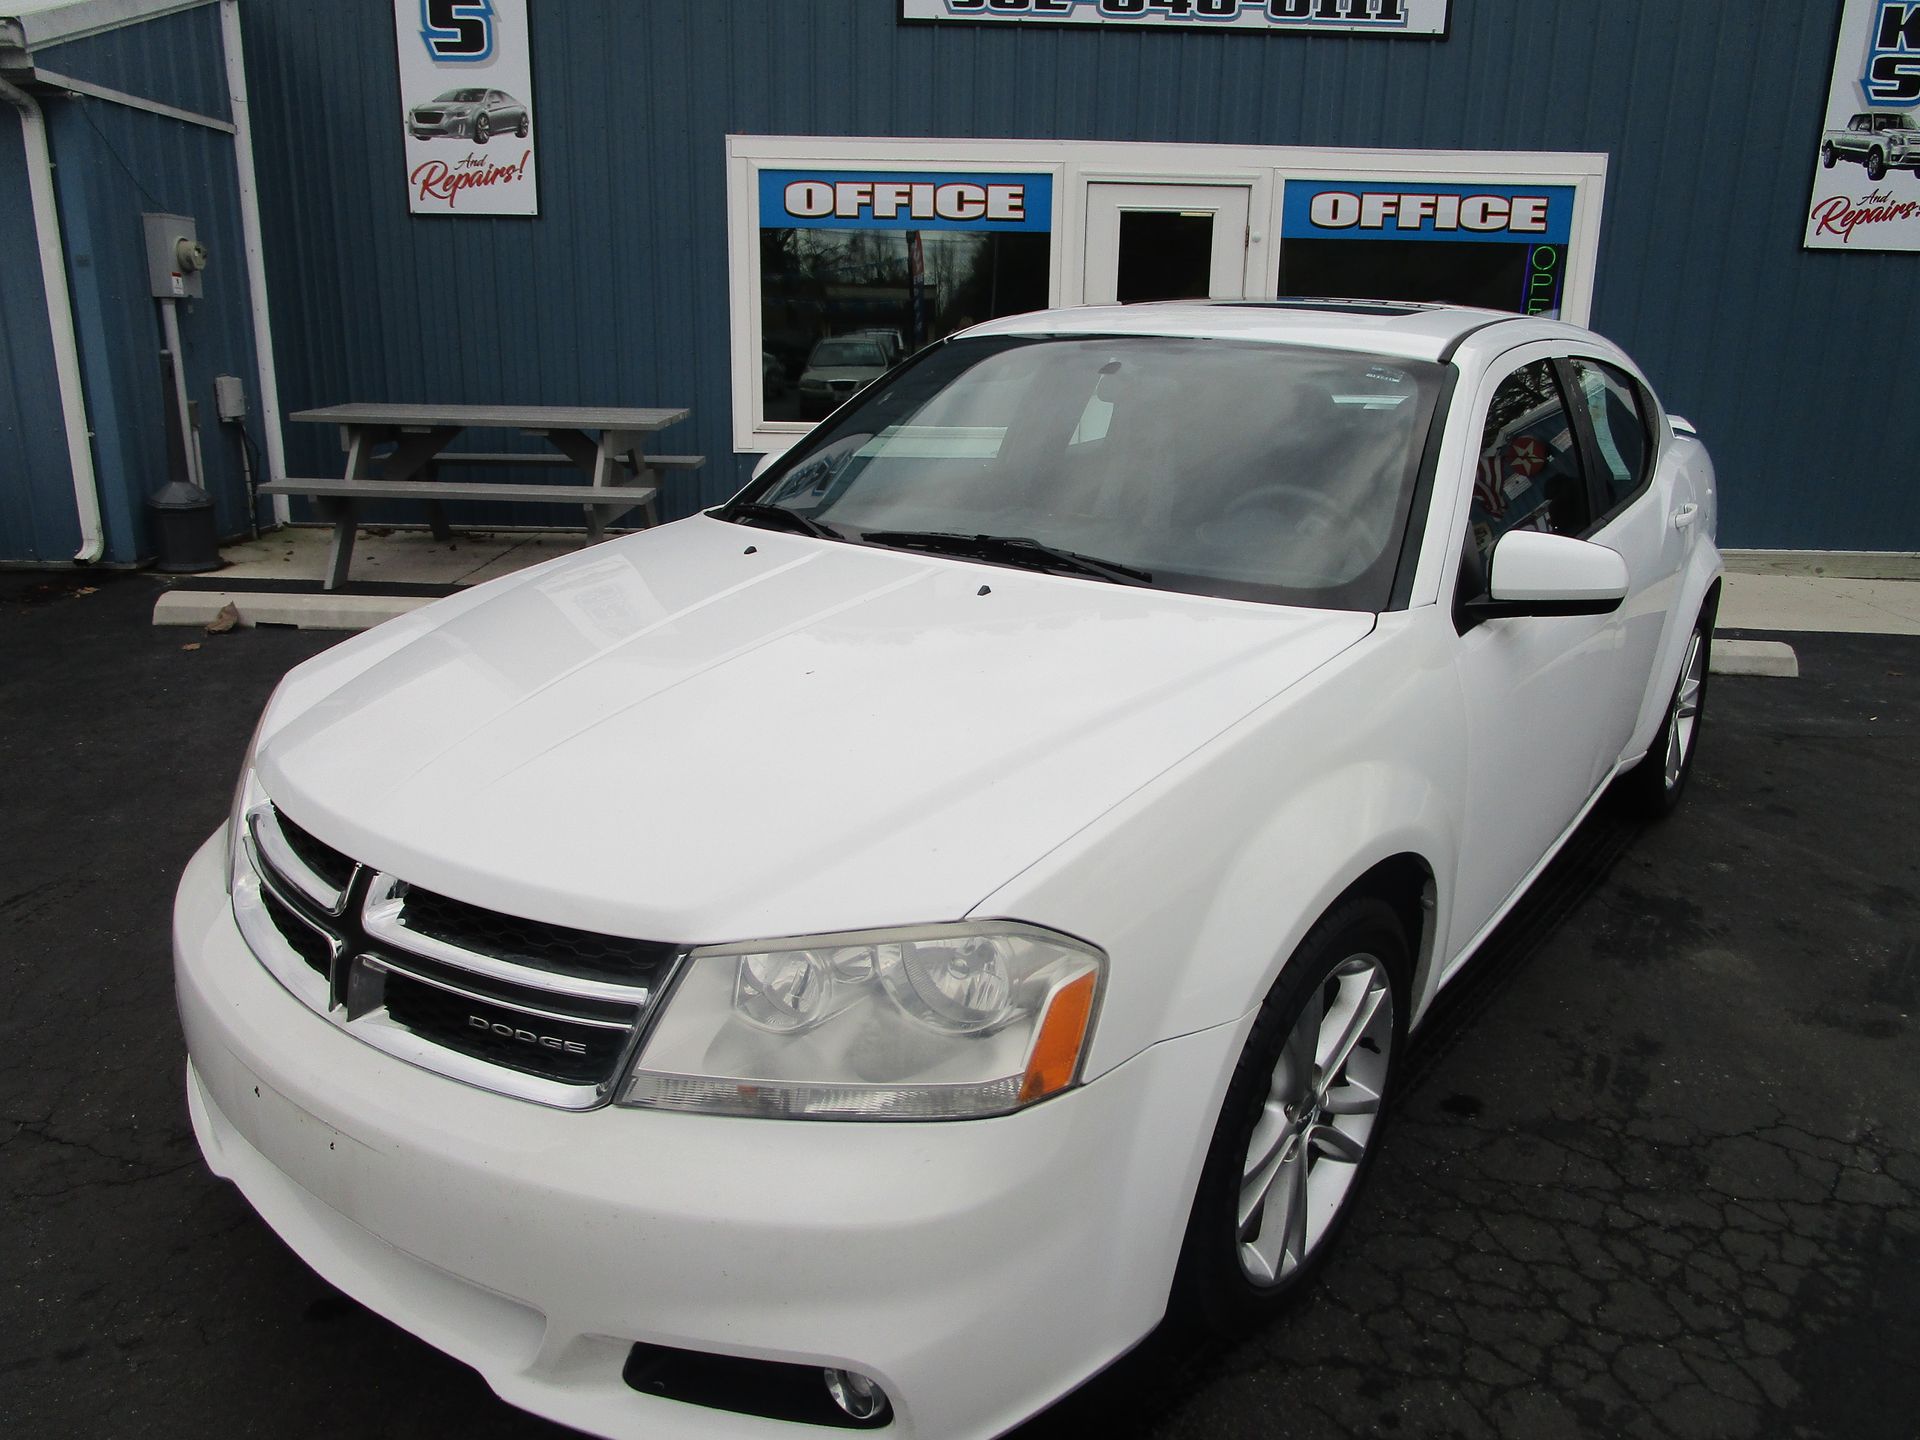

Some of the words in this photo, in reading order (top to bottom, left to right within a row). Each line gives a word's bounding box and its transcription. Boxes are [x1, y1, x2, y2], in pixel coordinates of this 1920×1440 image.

[410, 150, 531, 208] Repairs!
[454, 152, 488, 170] And
[784, 180, 1026, 222] OFFICE
[1309, 191, 1549, 233] OFFICE
[1856, 188, 1893, 206] And
[468, 1015, 587, 1055] DODGE
